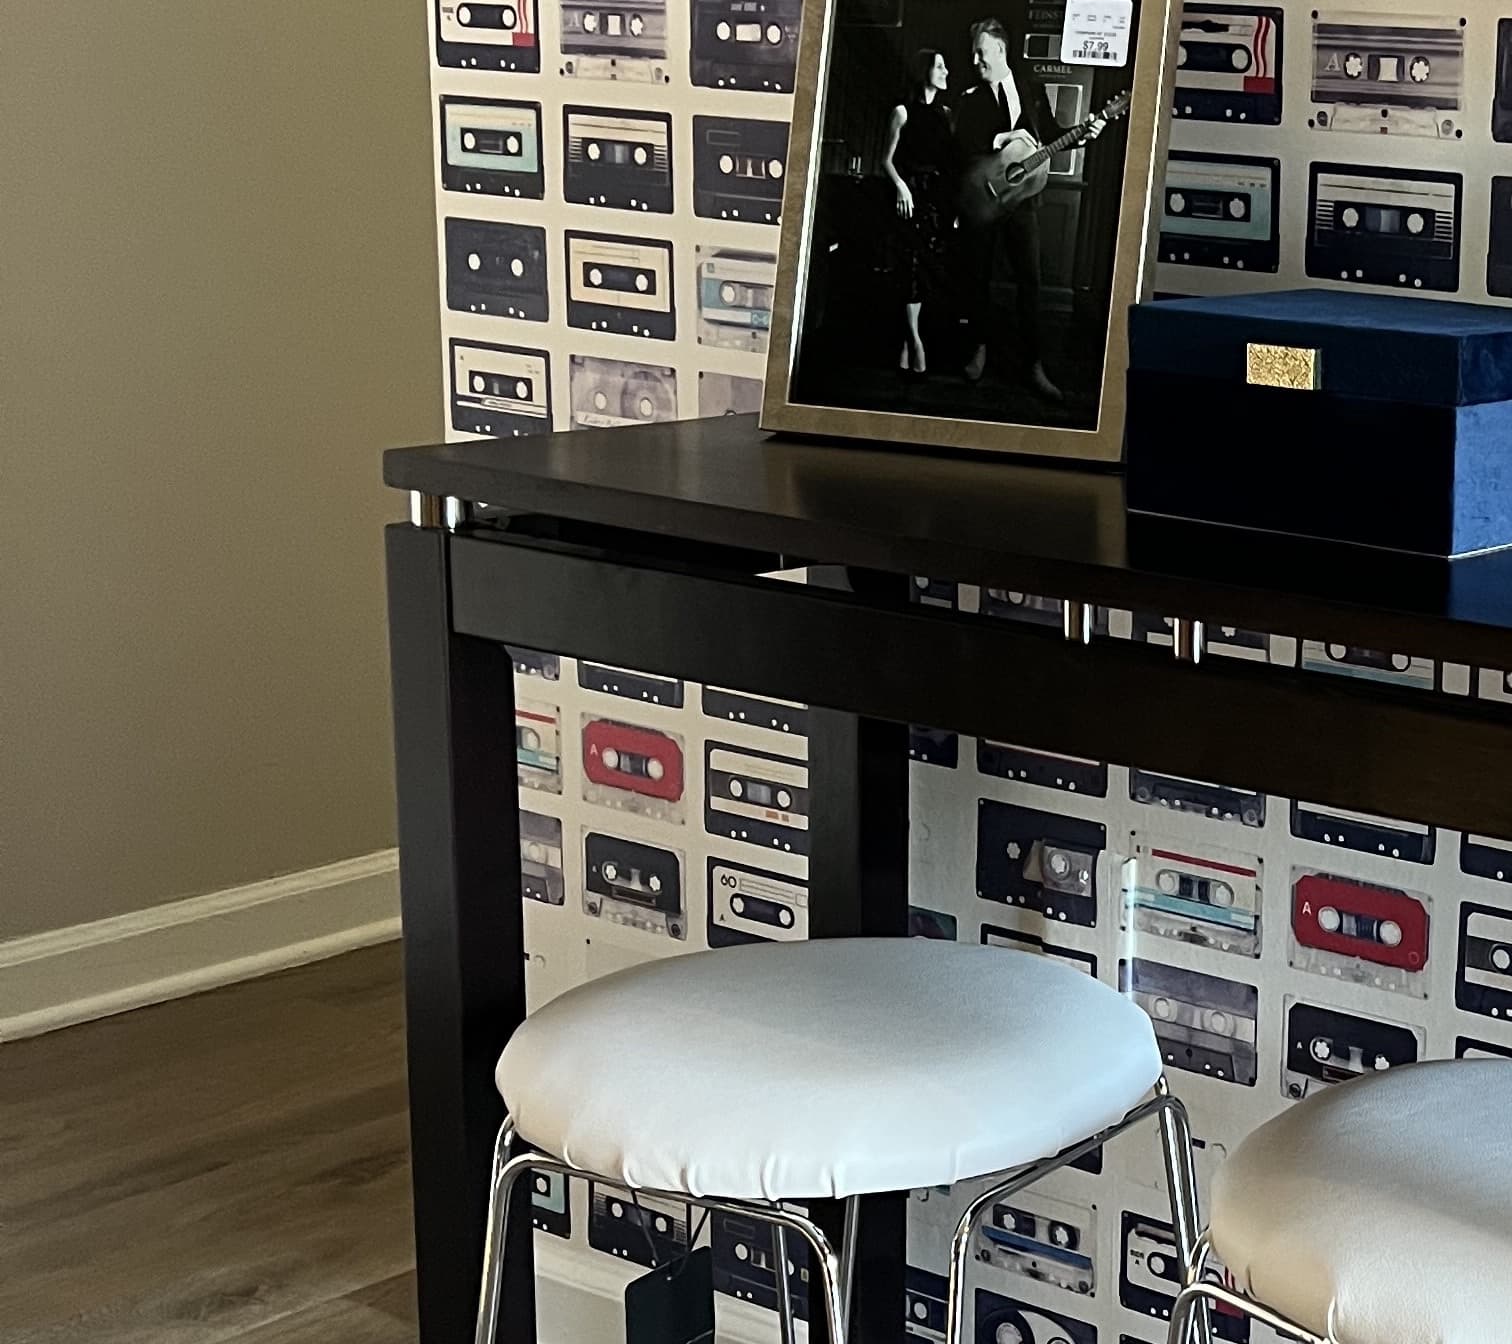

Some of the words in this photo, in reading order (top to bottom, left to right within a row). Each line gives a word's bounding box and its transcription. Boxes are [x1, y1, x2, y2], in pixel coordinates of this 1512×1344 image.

[1325, 52, 1341, 71] A
[1034, 65, 1073, 74] CARMEL
[589, 743, 599, 756] A
[721, 873, 737, 889] 60
[1302, 901, 1312, 916] A
[718, 913, 725, 922] A
